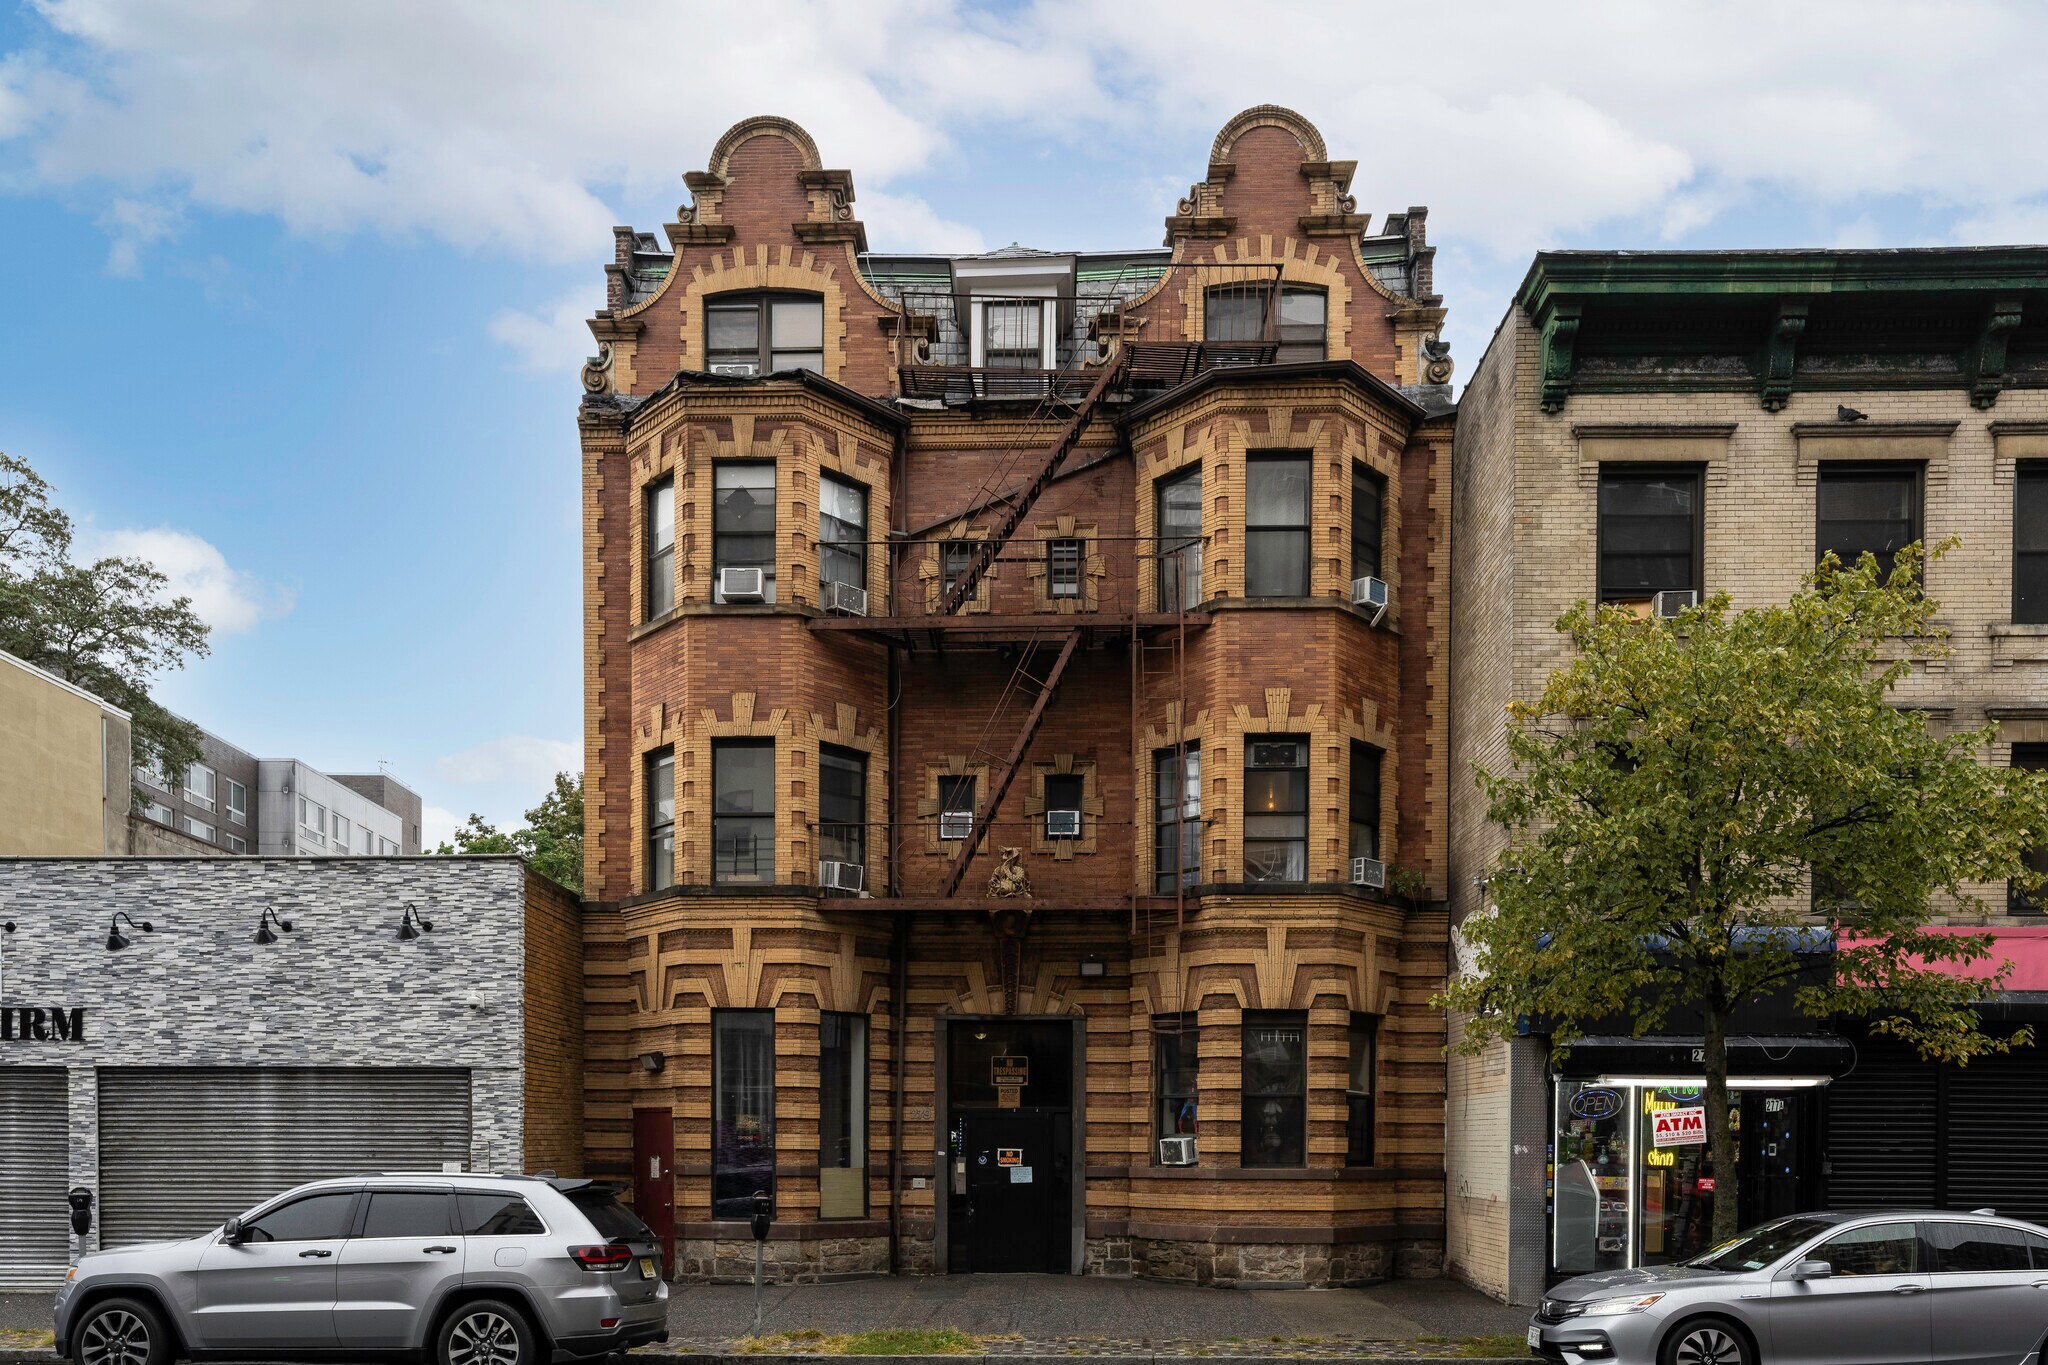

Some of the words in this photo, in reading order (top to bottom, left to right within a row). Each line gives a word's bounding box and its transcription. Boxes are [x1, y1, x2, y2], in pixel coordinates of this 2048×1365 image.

[0, 1008, 87, 1041] IRM
[993, 1066, 1027, 1075] TRESPASSING
[1574, 1095, 1616, 1113] OPEN
[1766, 1099, 1784, 1112] 277A
[1656, 1116, 1702, 1132] ATM
